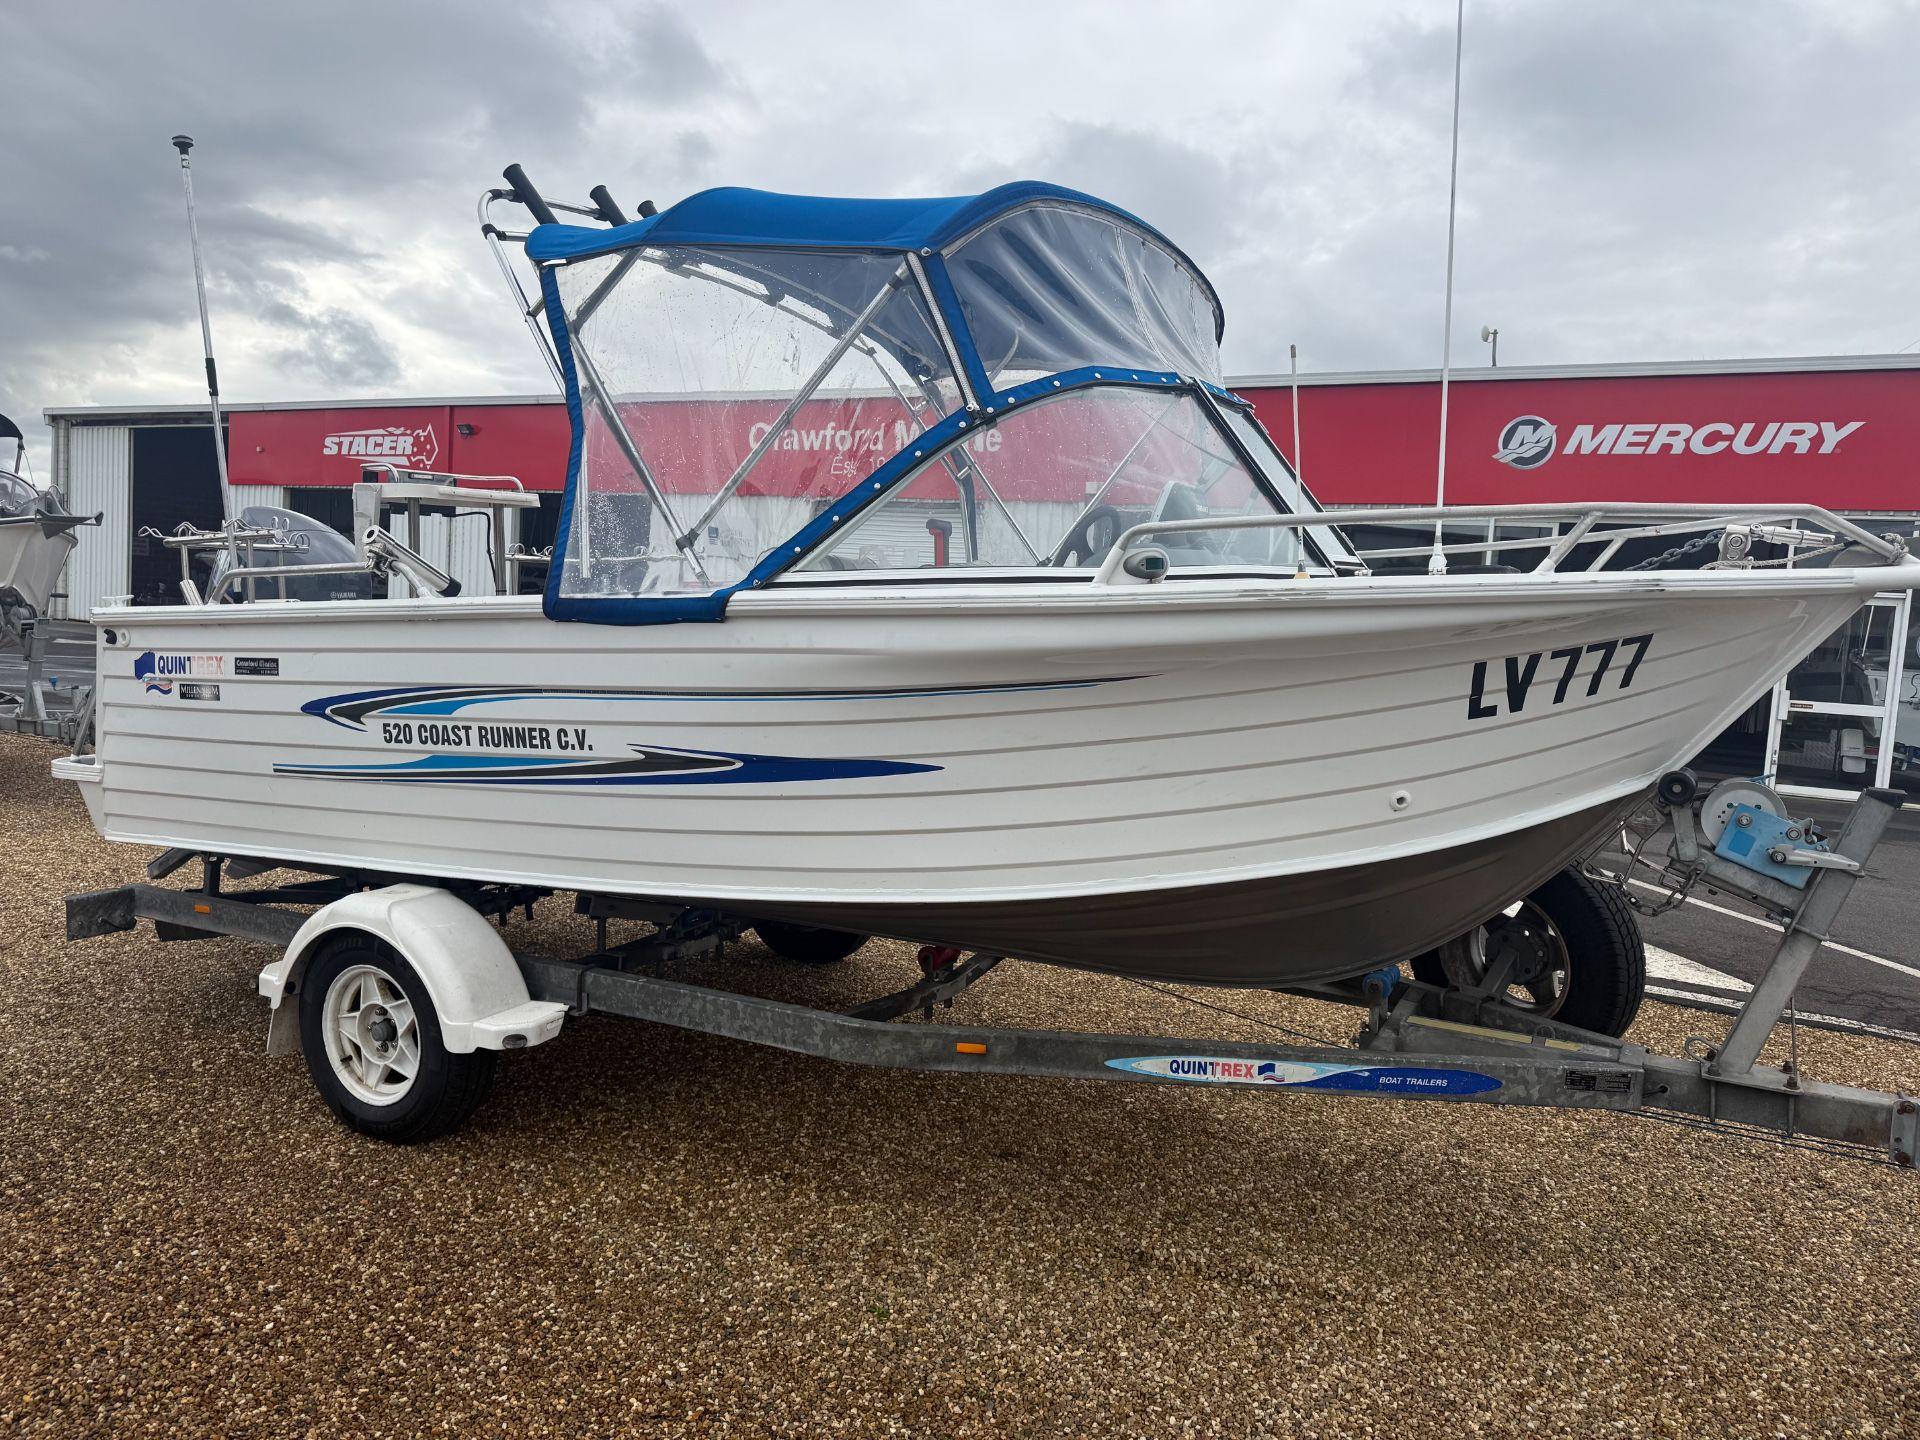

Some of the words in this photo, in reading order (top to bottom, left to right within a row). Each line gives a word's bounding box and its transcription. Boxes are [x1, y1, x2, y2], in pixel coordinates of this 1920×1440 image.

[323, 436, 414, 455] STACER
[748, 422, 885, 451] Crawford
[1562, 421, 1867, 455] MERCURY
[382, 722, 412, 744] 520
[417, 723, 472, 747] COAST
[477, 725, 552, 750] RUNNER
[556, 727, 593, 751] C.V.
[1169, 1059, 1255, 1079] QUINTREX
[1379, 1076, 1402, 1085] BOAT
[1405, 1077, 1448, 1087] TRAILERS
